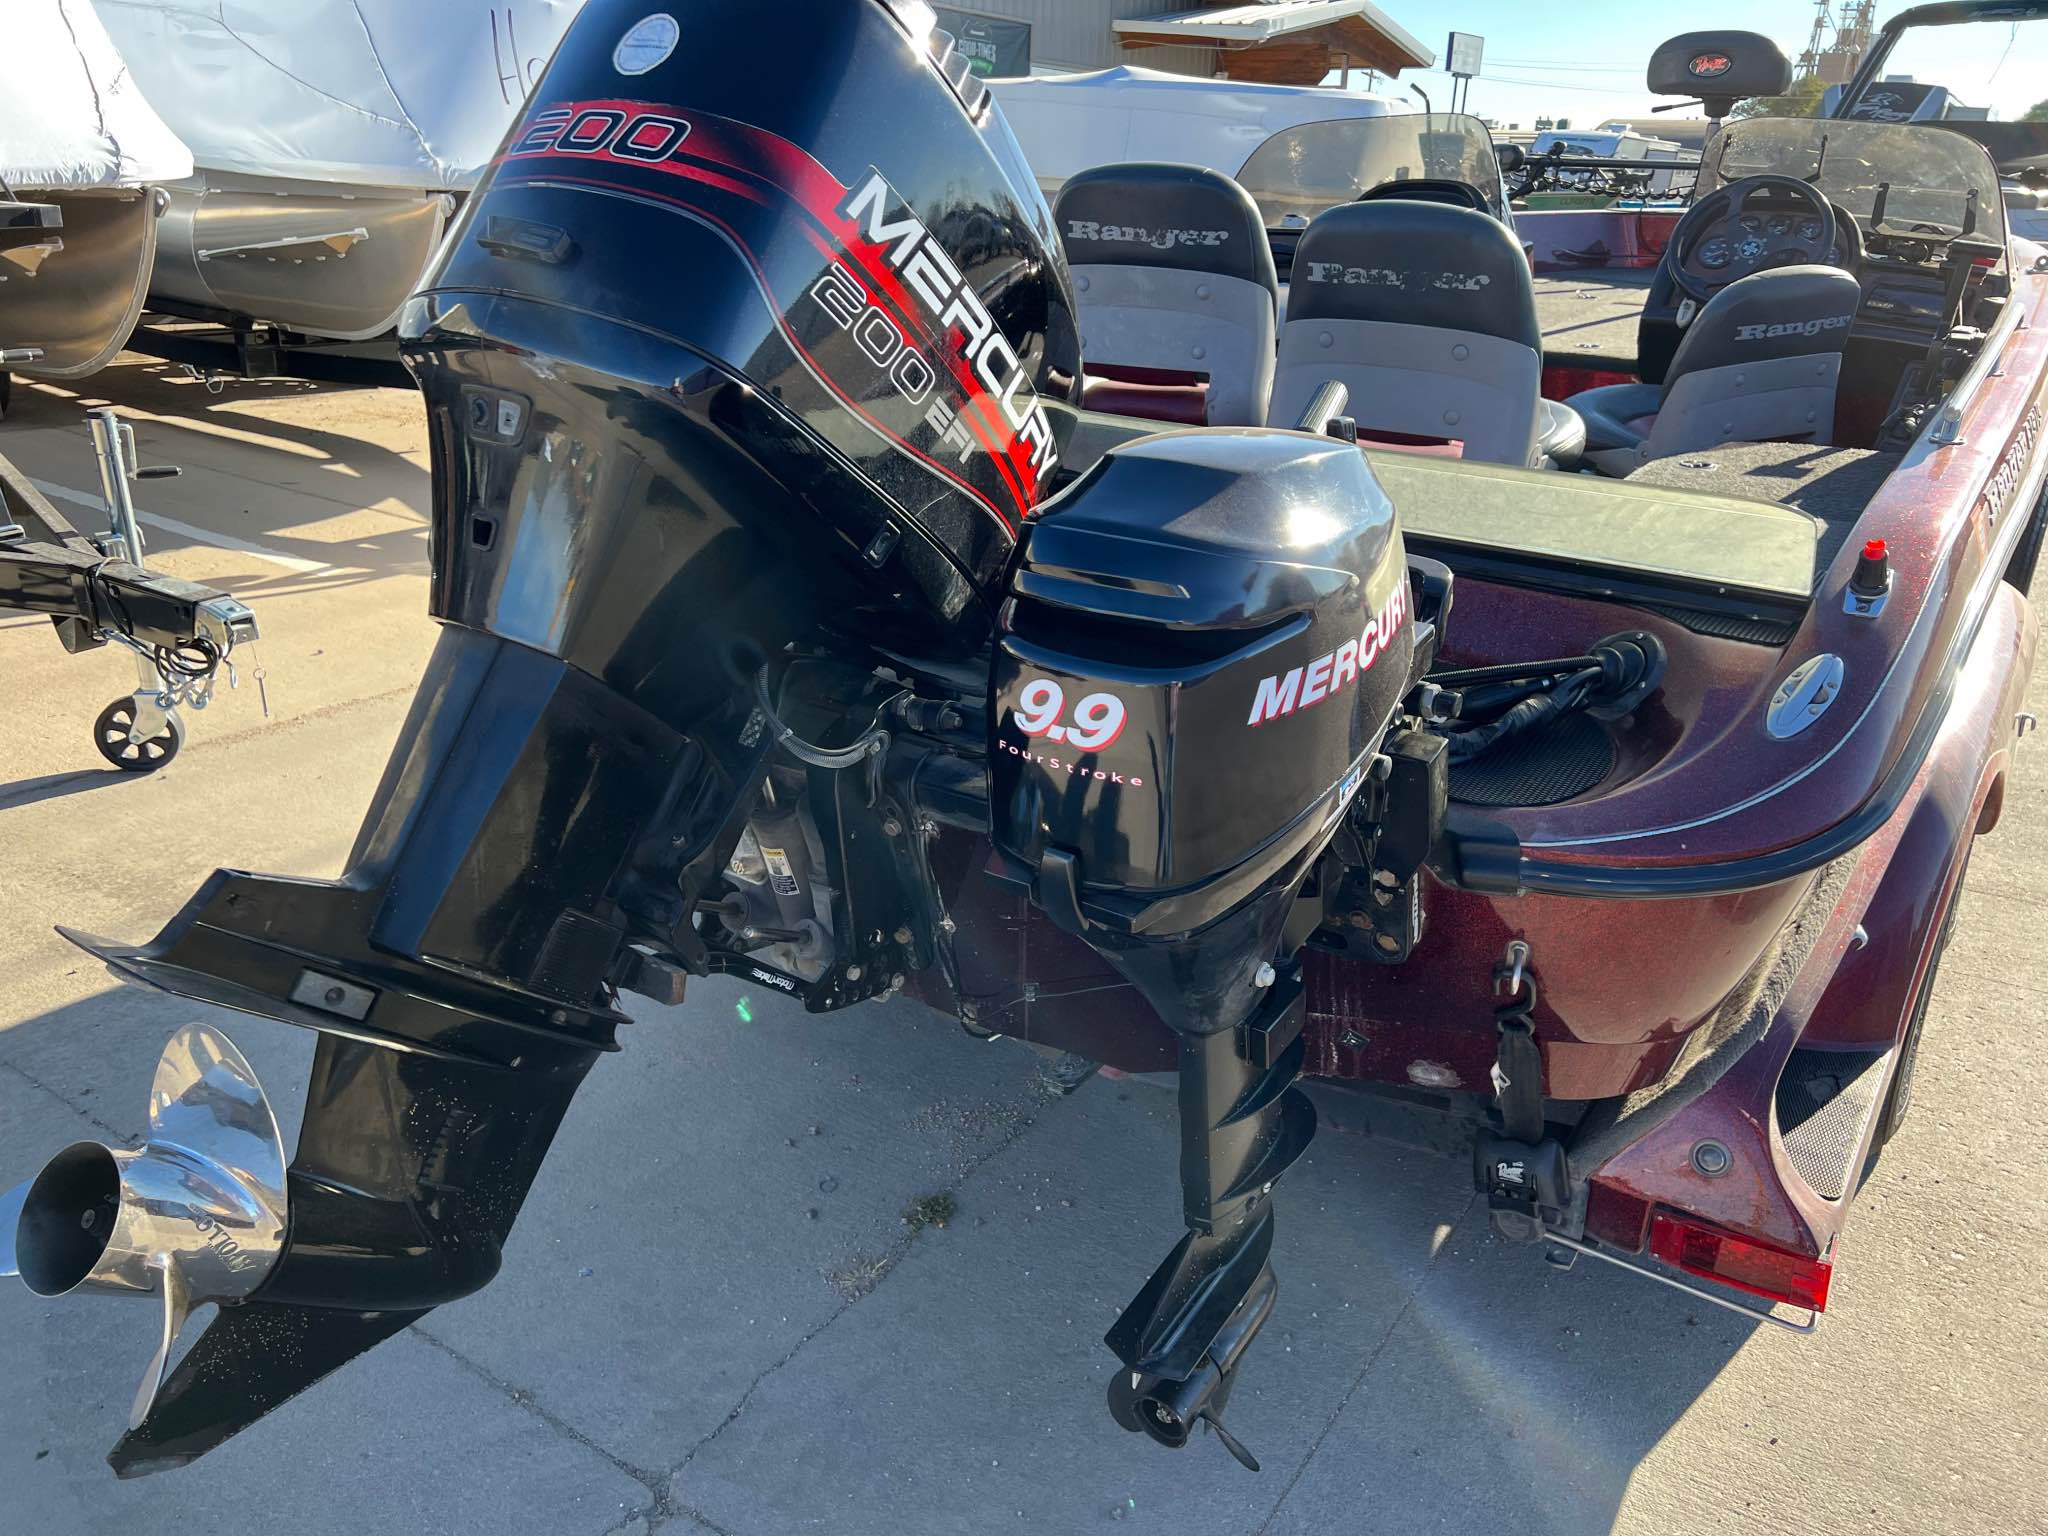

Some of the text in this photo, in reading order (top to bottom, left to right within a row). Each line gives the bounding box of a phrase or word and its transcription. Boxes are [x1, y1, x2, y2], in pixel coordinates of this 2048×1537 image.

[510, 109, 692, 163] 200
[1067, 220, 1230, 249] Ranger
[1307, 262, 1491, 291] Raner
[846, 173, 1058, 481] MERCURY
[1734, 315, 1851, 341] Ranger
[810, 261, 976, 464] 200 EFI
[1247, 576, 1410, 727] MERCURY
[1013, 679, 1128, 753] 9.9
[999, 739, 1144, 787] FourStroke
